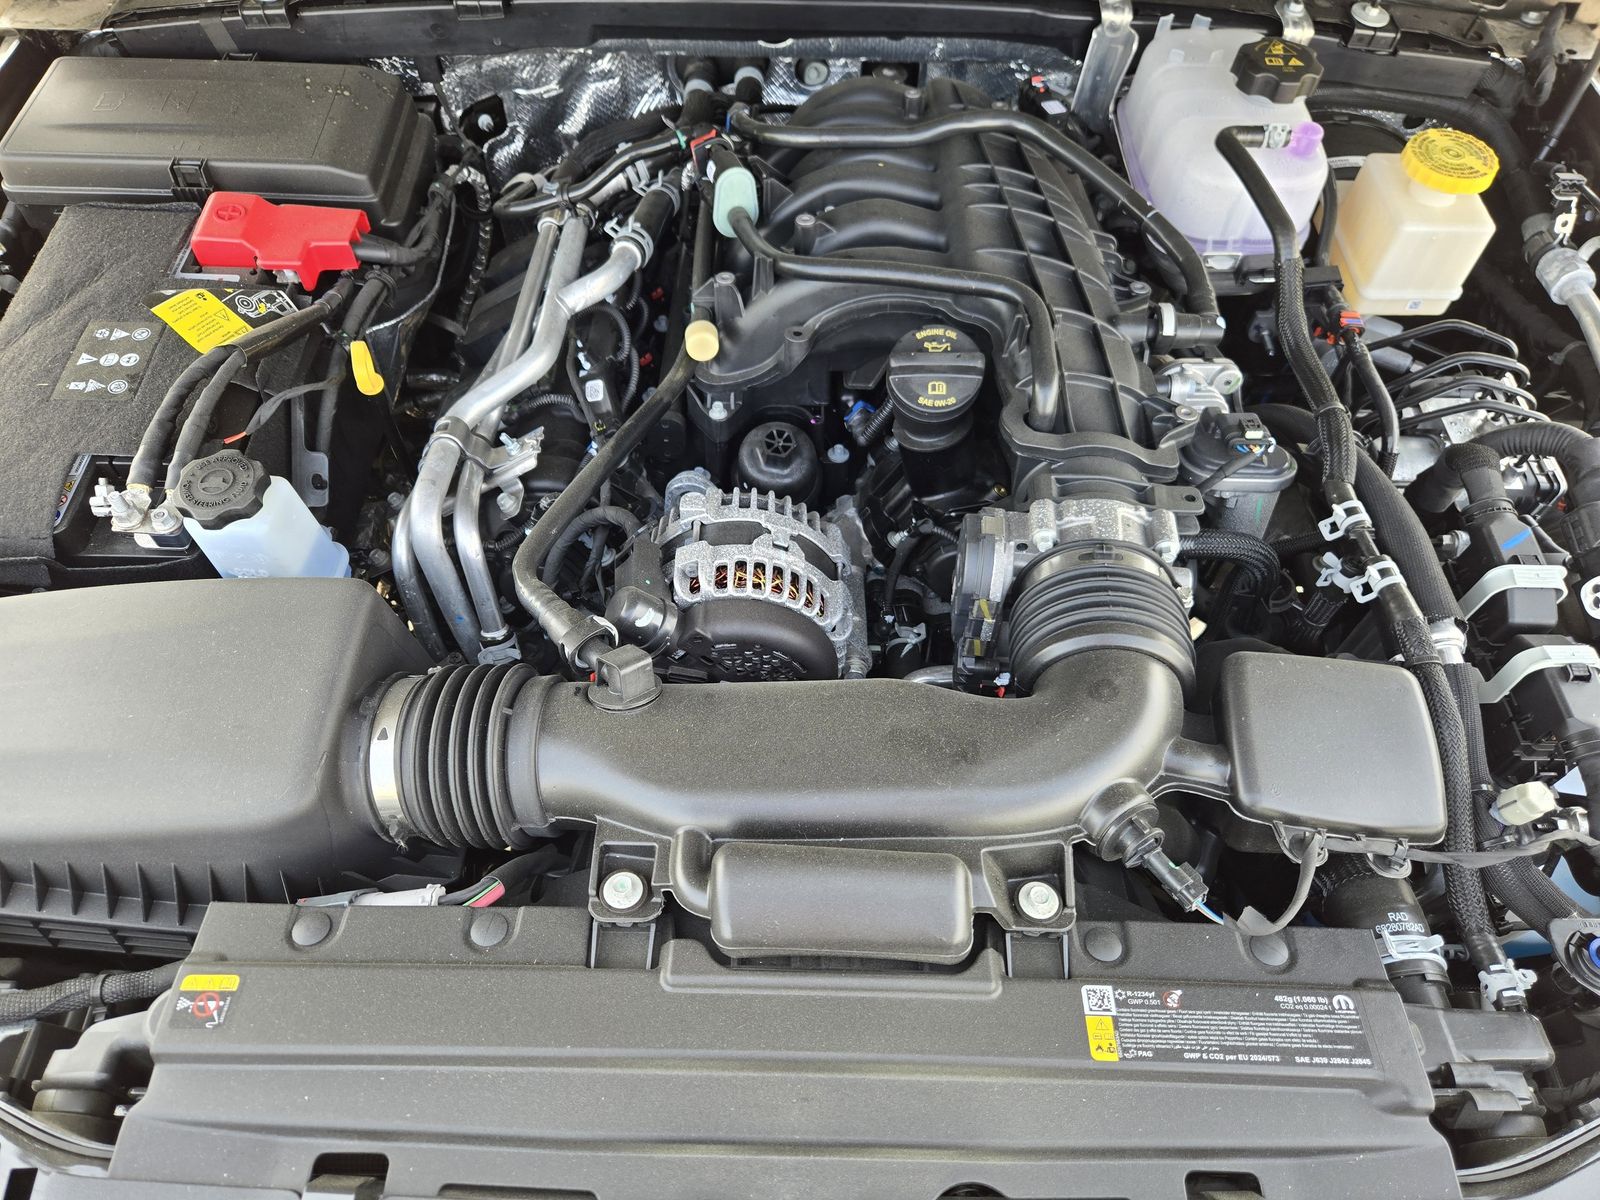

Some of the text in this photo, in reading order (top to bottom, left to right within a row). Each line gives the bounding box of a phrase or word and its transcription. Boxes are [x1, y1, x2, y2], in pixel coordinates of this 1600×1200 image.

[916, 328, 958, 340] ENGINE OIL
[917, 396, 957, 407] SAE 0W-20
[211, 455, 247, 471] APPROVED
[1388, 912, 1408, 922] RAD
[1126, 991, 1155, 999] R-1234yf
[1274, 995, 1293, 1004] 482g
[1317, 996, 1328, 1004] lb)
[1137, 1050, 1154, 1058] PAG
